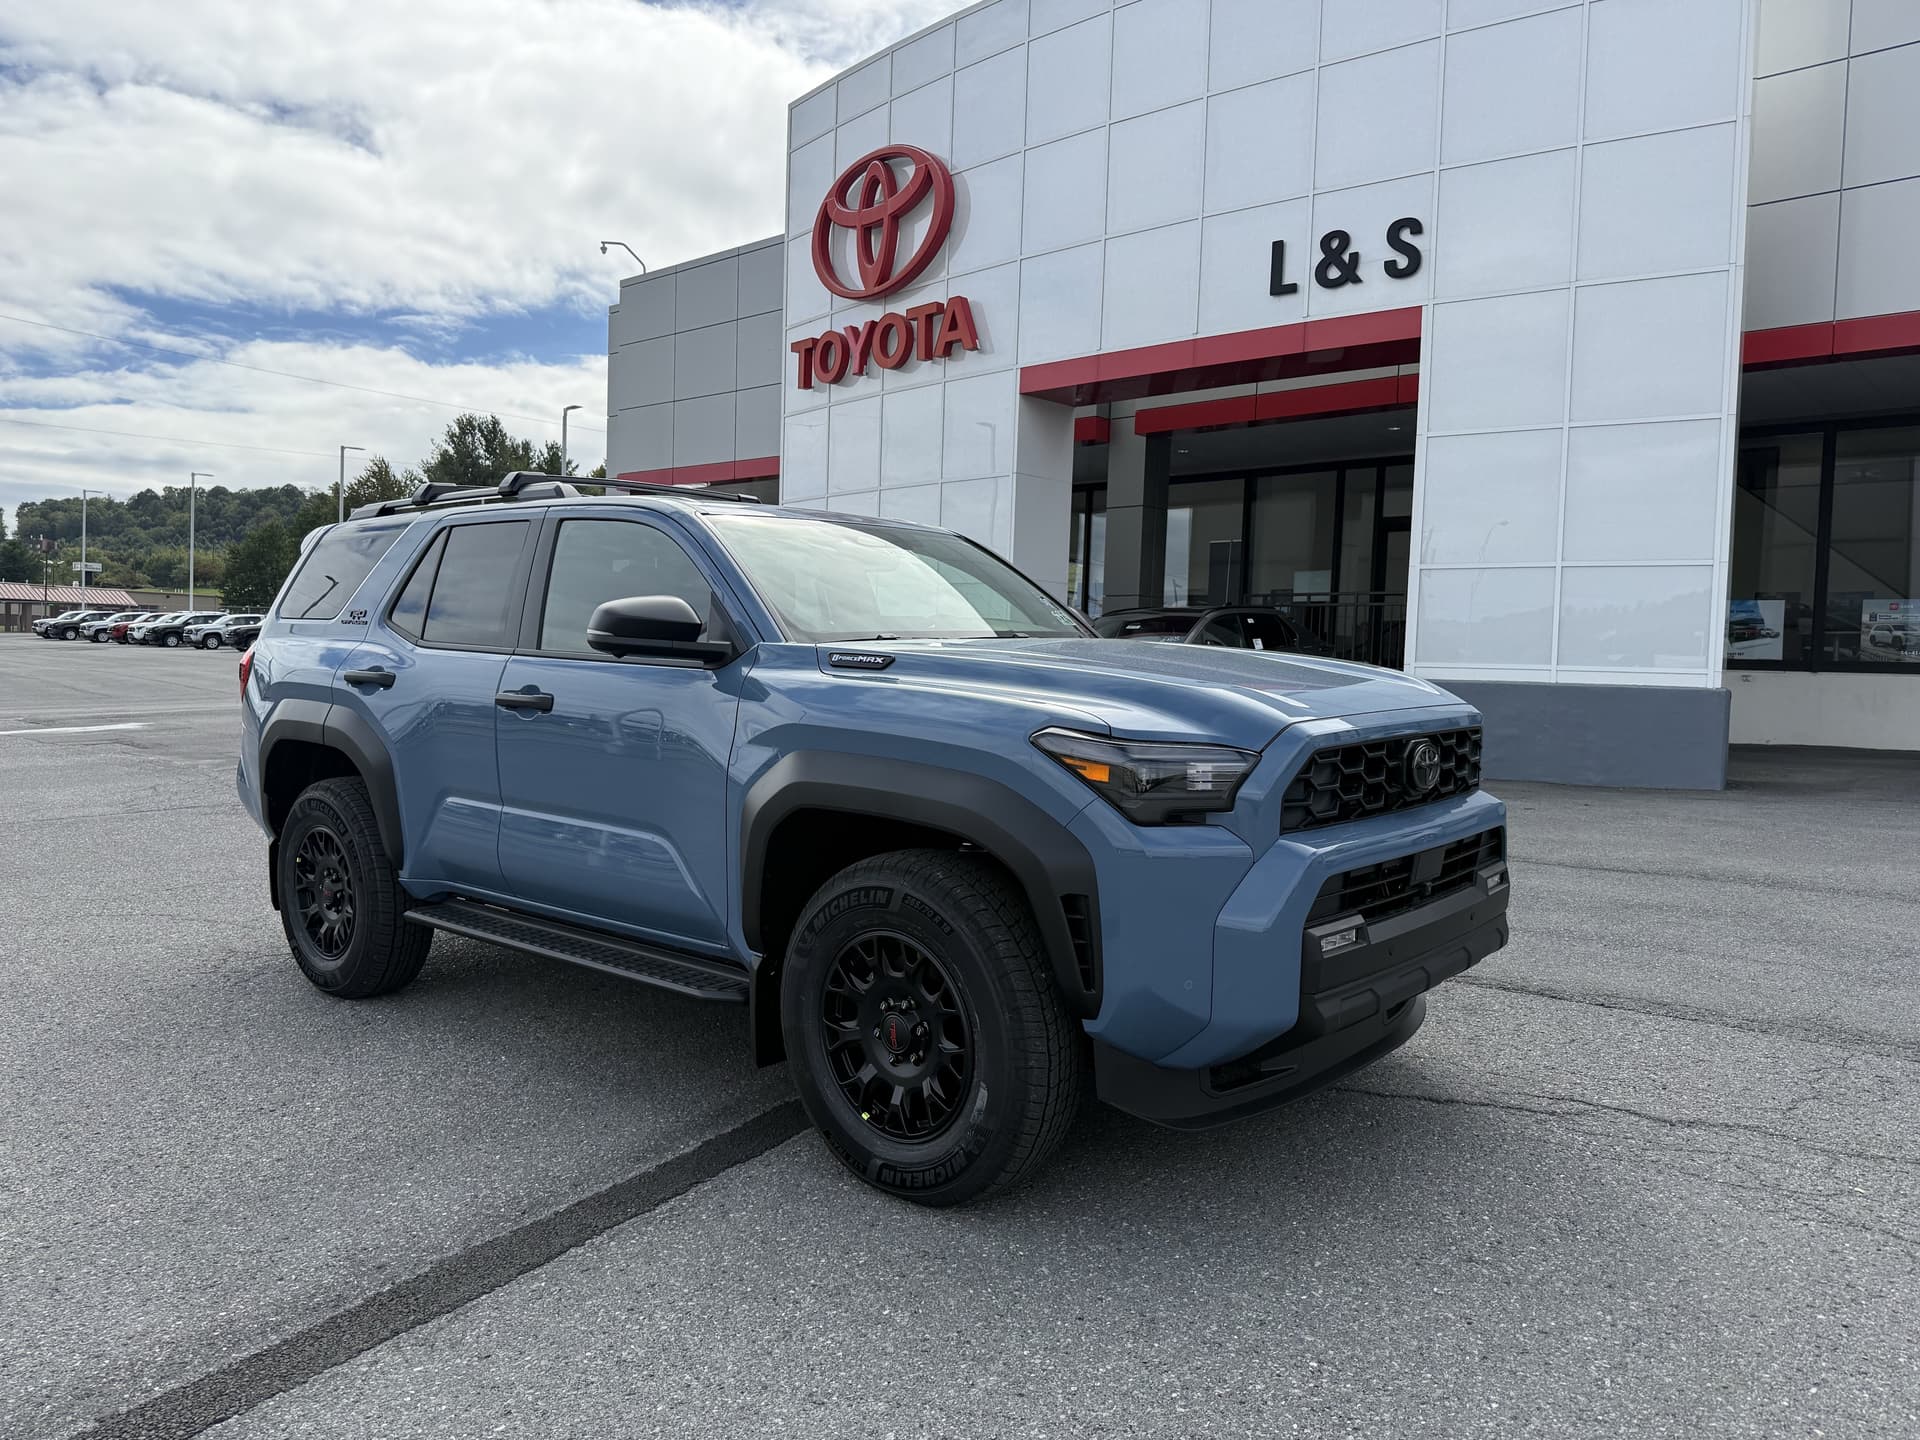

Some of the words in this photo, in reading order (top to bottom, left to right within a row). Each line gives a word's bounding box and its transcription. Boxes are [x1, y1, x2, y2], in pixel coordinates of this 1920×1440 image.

[1270, 239, 1298, 296] L
[1314, 229, 1363, 289] &
[1383, 217, 1424, 279] S
[791, 295, 979, 390] TOYOTA
[812, 888, 891, 931] MICHELIN
[879, 1148, 968, 1187] MICHELIN
